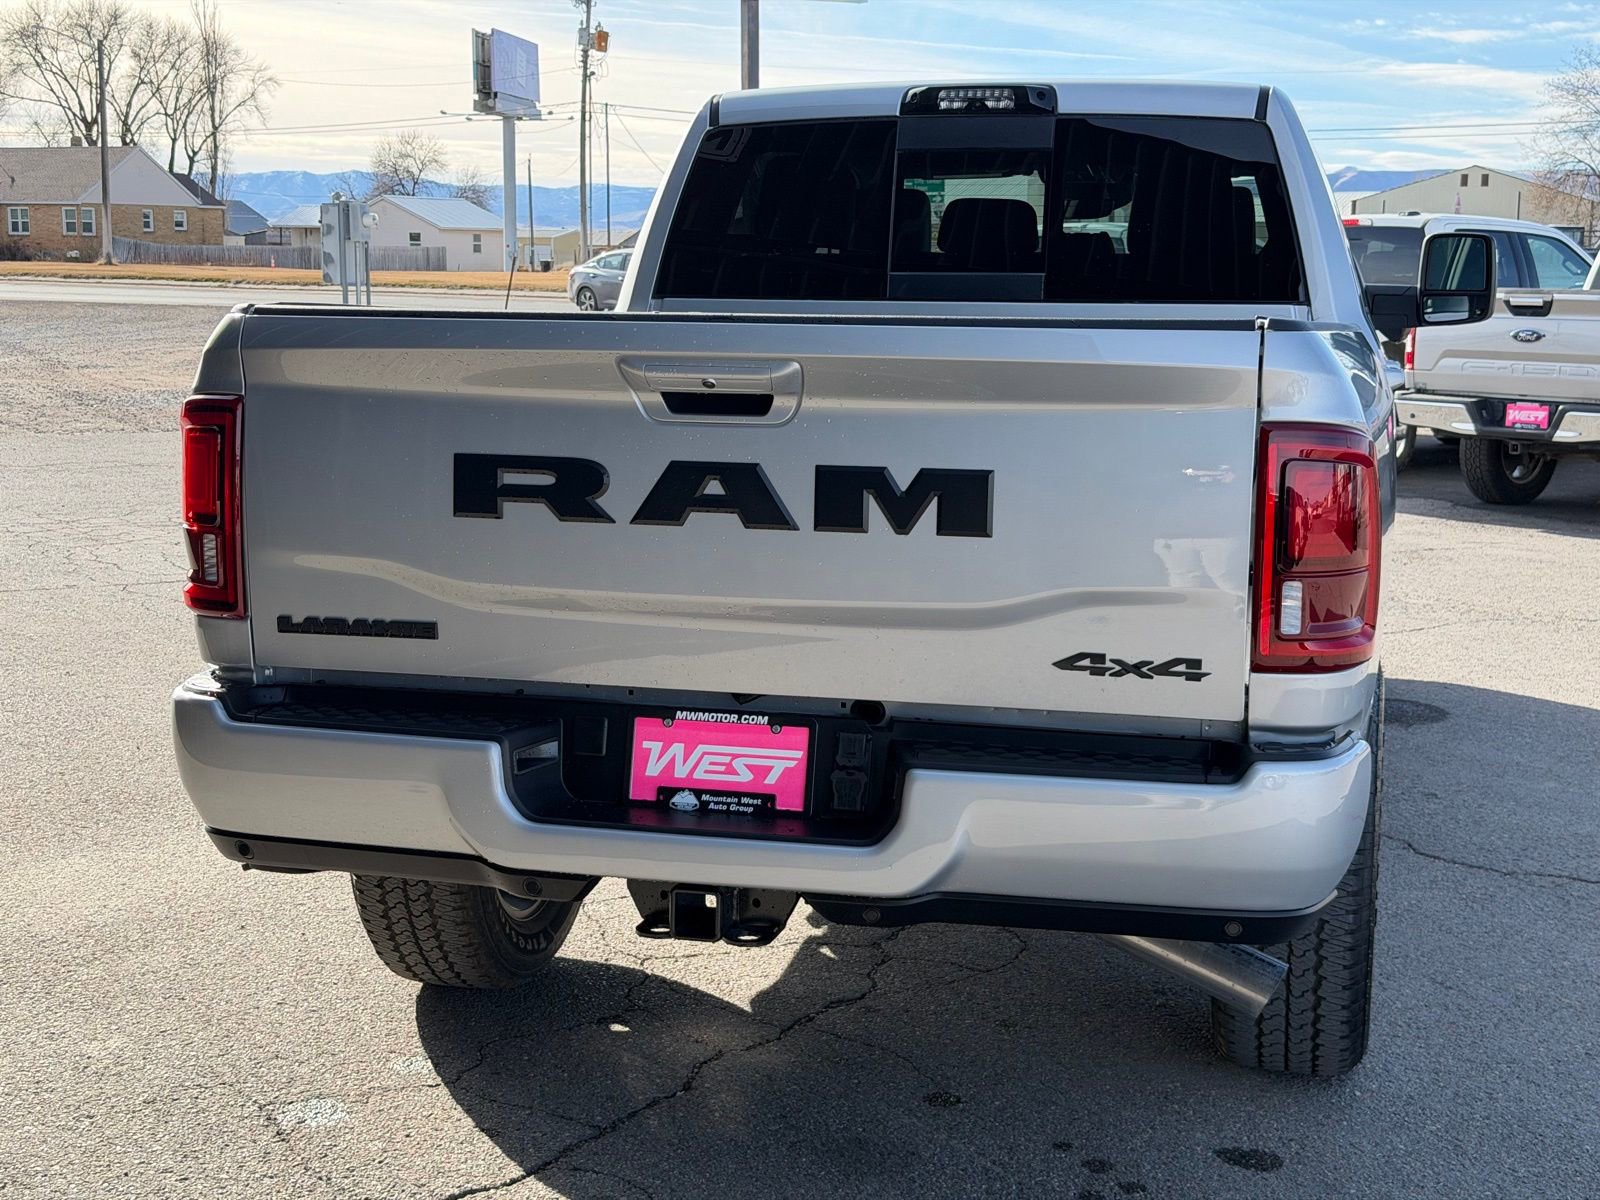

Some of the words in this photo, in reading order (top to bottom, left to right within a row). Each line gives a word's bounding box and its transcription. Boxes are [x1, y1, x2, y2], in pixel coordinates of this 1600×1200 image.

[1516, 330, 1539, 341] Ford
[1508, 409, 1546, 422] WEST
[453, 452, 994, 538] RAM
[675, 710, 769, 725] MWMOTOR.COM
[642, 740, 804, 784] WEST
[701, 794, 738, 804] Mountain
[741, 797, 762, 805] West
[708, 802, 728, 811] Auto
[729, 803, 754, 813] Group
